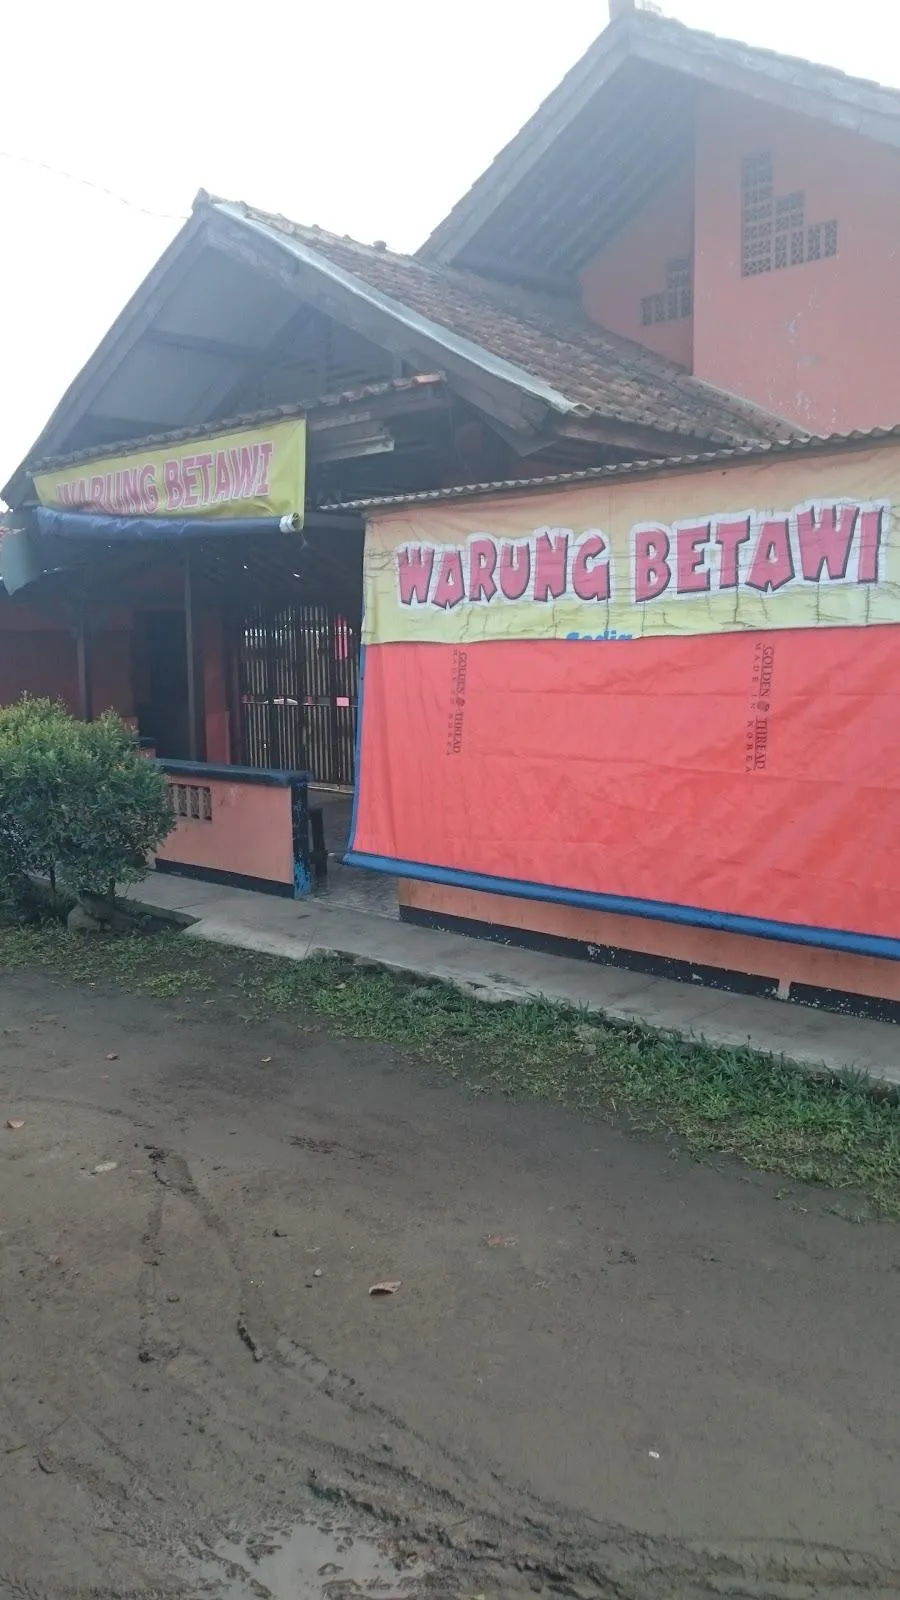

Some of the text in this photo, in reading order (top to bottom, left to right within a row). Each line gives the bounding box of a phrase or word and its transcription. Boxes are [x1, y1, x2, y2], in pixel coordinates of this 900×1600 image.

[55, 442, 274, 513] WARUNG BETAWI
[397, 500, 886, 610] WARUNG BETAWI
[453, 651, 467, 754] GOLDEN THREAD
[752, 642, 762, 682] MADE
[745, 720, 754, 773] KOREA
[755, 646, 774, 769] GOLDEN THREAD
